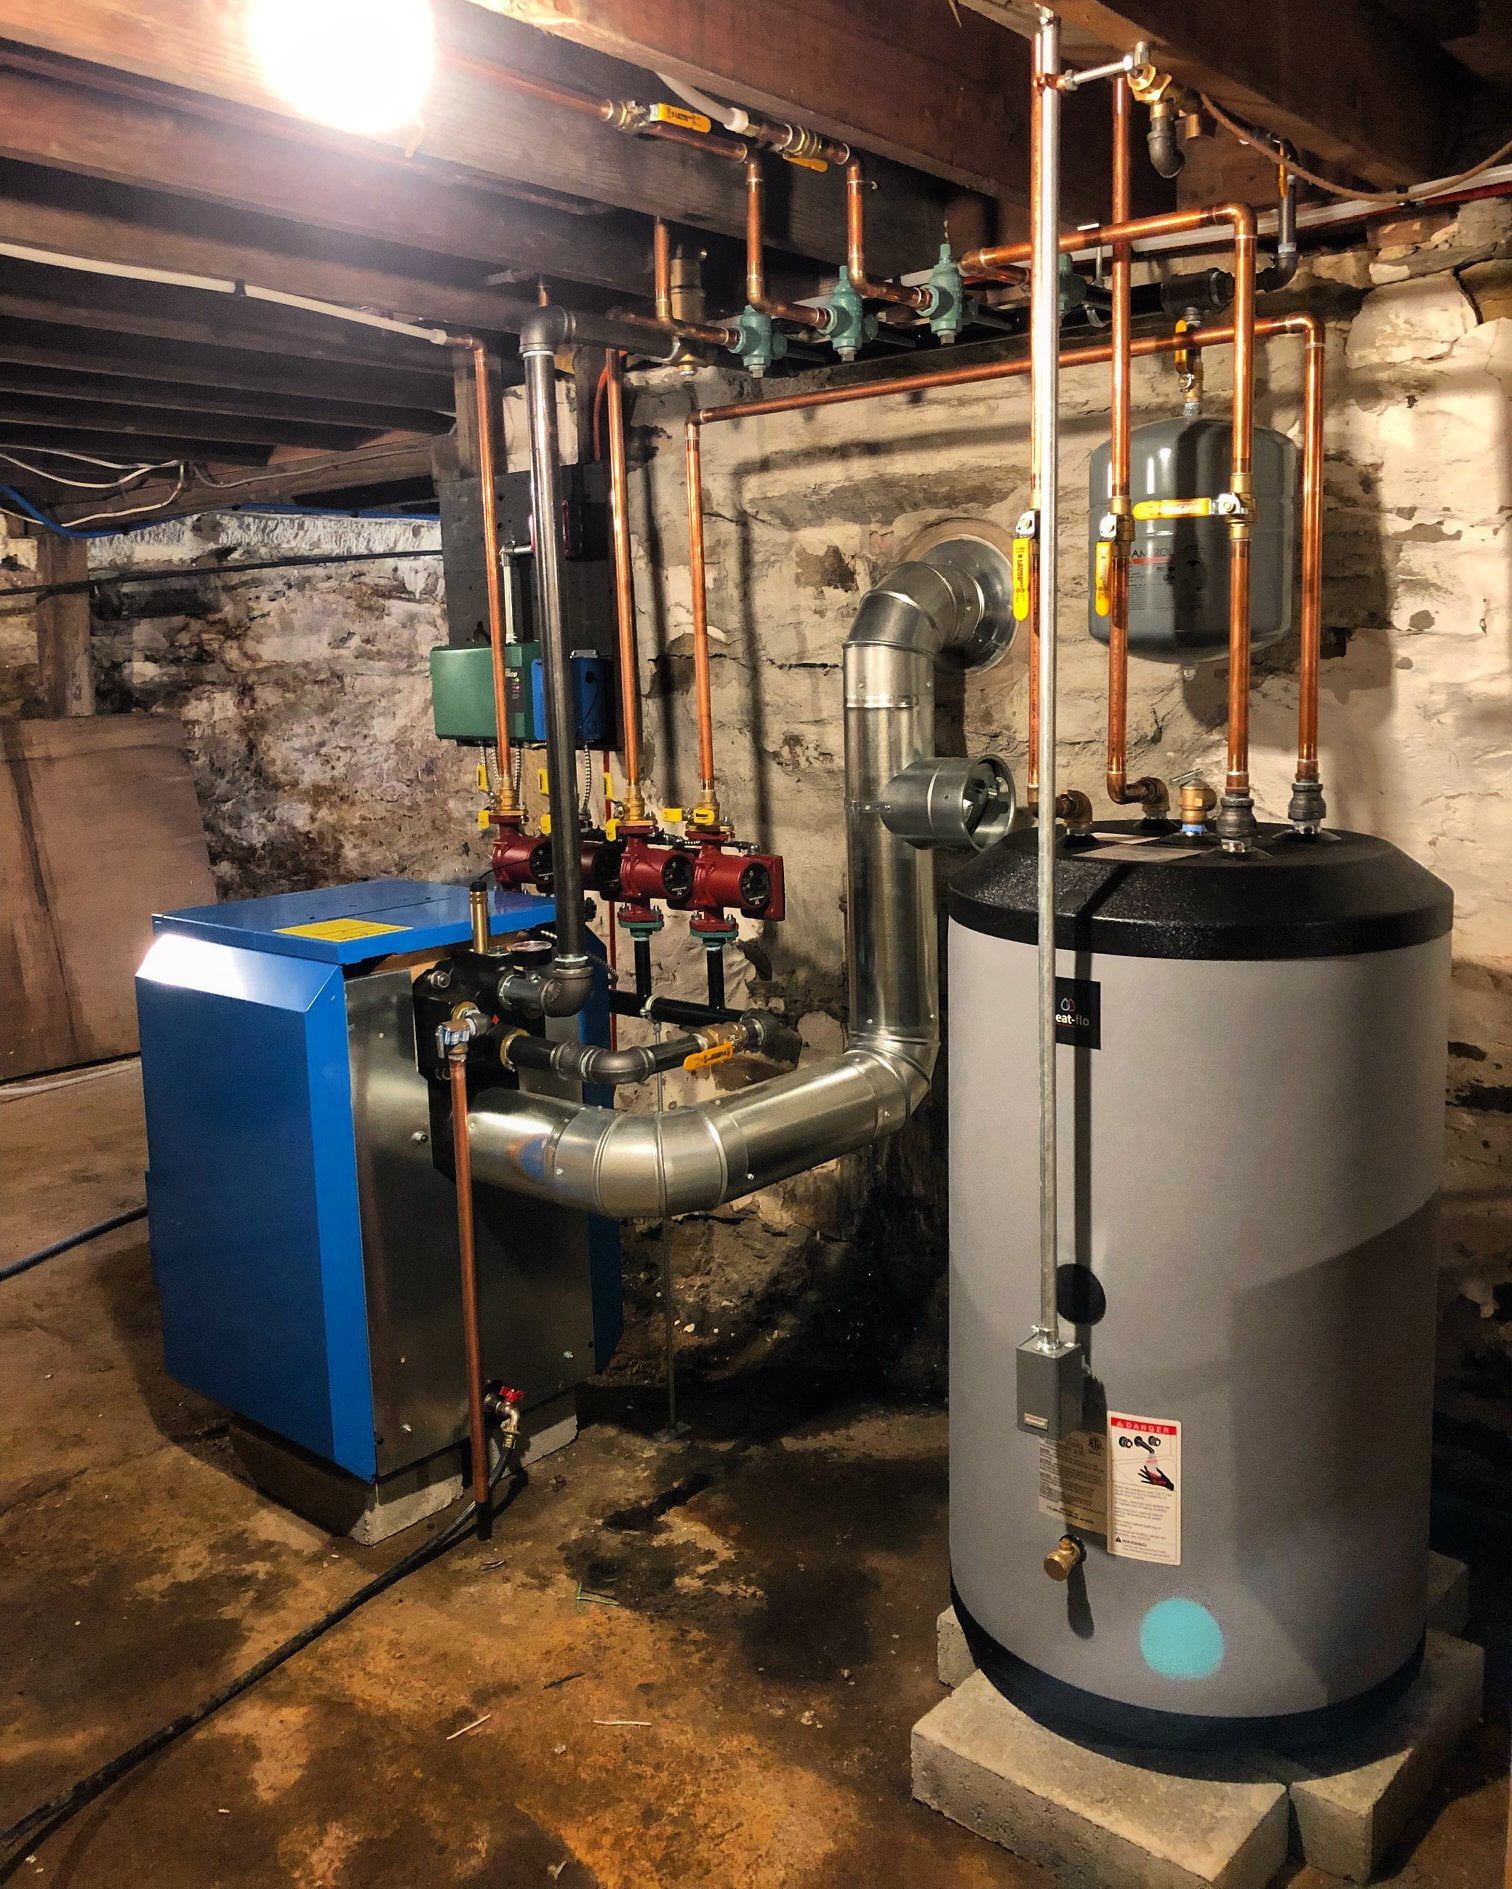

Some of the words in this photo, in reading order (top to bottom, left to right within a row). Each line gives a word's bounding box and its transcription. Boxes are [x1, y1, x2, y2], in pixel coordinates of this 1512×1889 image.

[1131, 547, 1174, 558] AMRO
[1055, 1014, 1090, 1026] eat-flo
[1125, 1421, 1170, 1434] DANGER
